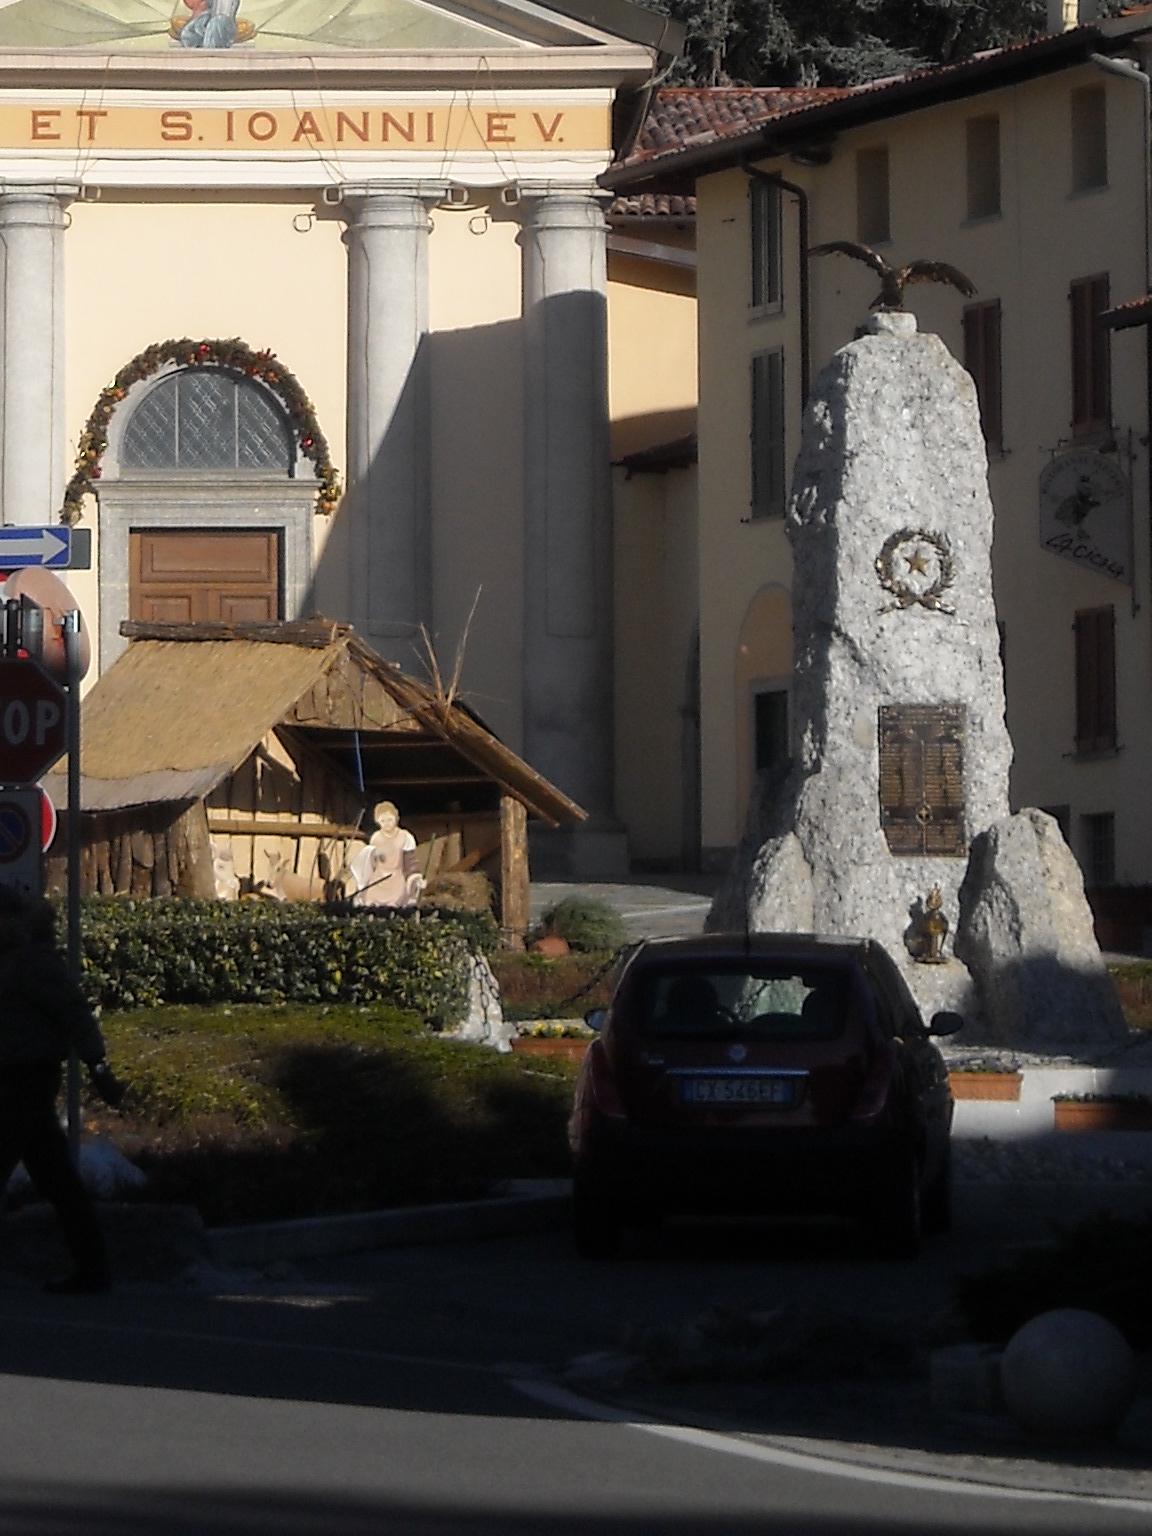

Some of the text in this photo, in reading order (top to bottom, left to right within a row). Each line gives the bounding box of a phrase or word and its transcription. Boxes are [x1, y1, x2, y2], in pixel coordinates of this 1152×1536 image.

[31, 111, 108, 142] ET
[160, 111, 205, 143] S.
[226, 112, 436, 145] IOANNI
